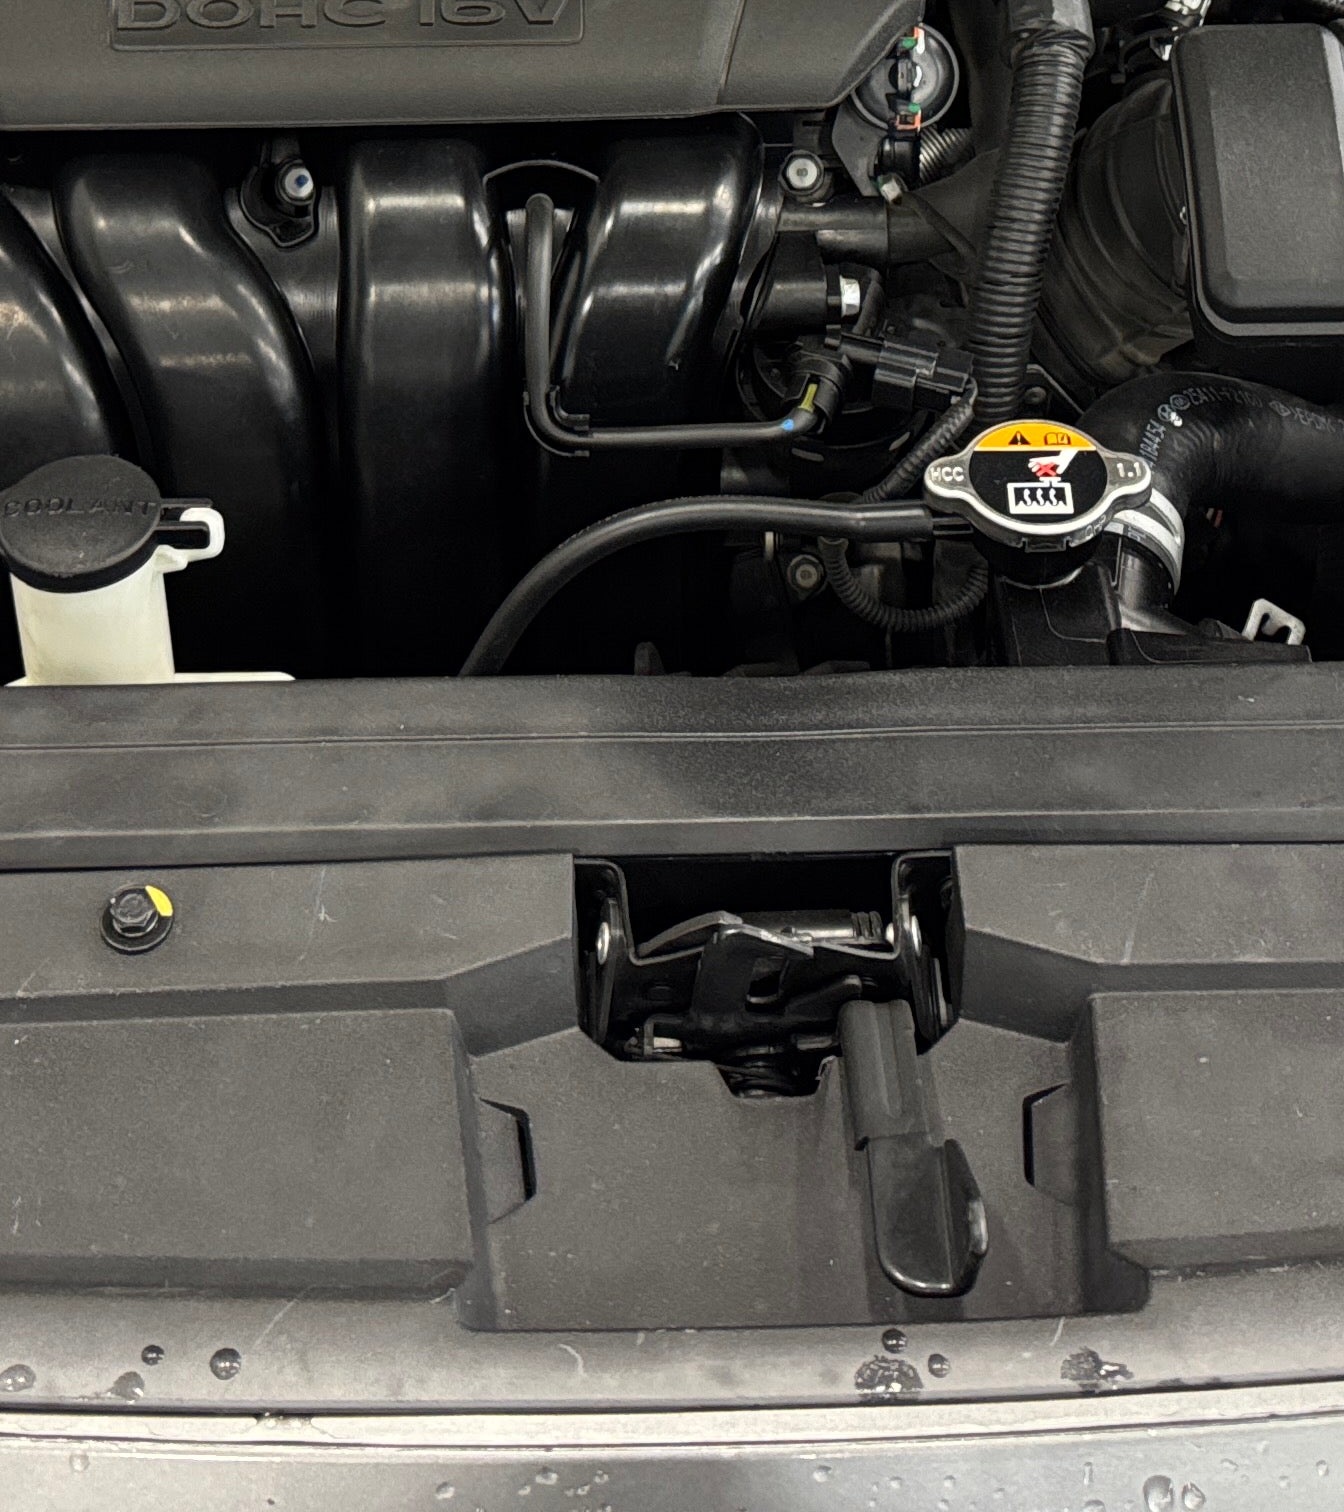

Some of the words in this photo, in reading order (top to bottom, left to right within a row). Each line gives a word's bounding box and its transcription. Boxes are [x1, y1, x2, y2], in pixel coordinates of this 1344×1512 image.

[930, 466, 965, 482] HCC
[1116, 462, 1142, 479] 1.1
[3, 497, 157, 518] COOLANT
